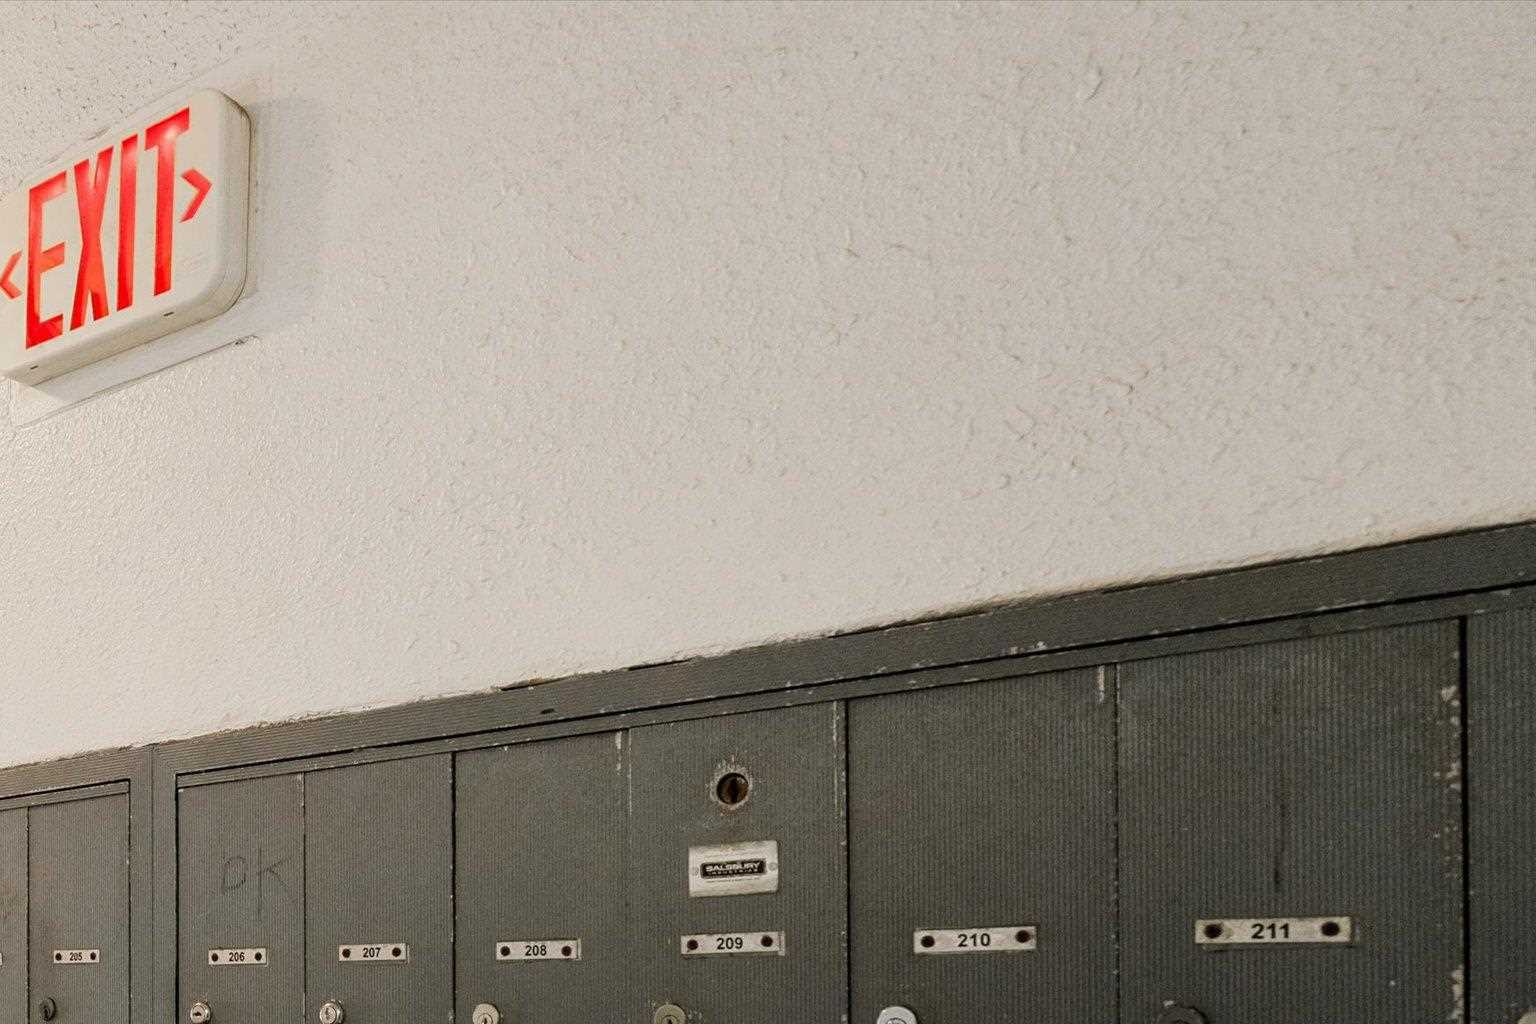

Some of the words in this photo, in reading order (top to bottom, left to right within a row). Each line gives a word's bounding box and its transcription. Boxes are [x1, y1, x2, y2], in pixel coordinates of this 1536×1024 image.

[26, 107, 190, 349] EXIT
[1251, 923, 1290, 939] 211
[716, 937, 744, 950] 209
[957, 932, 991, 947] 210
[69, 952, 83, 962] 205
[228, 951, 245, 962] 206
[362, 947, 382, 958] 207
[524, 944, 547, 957] 208
